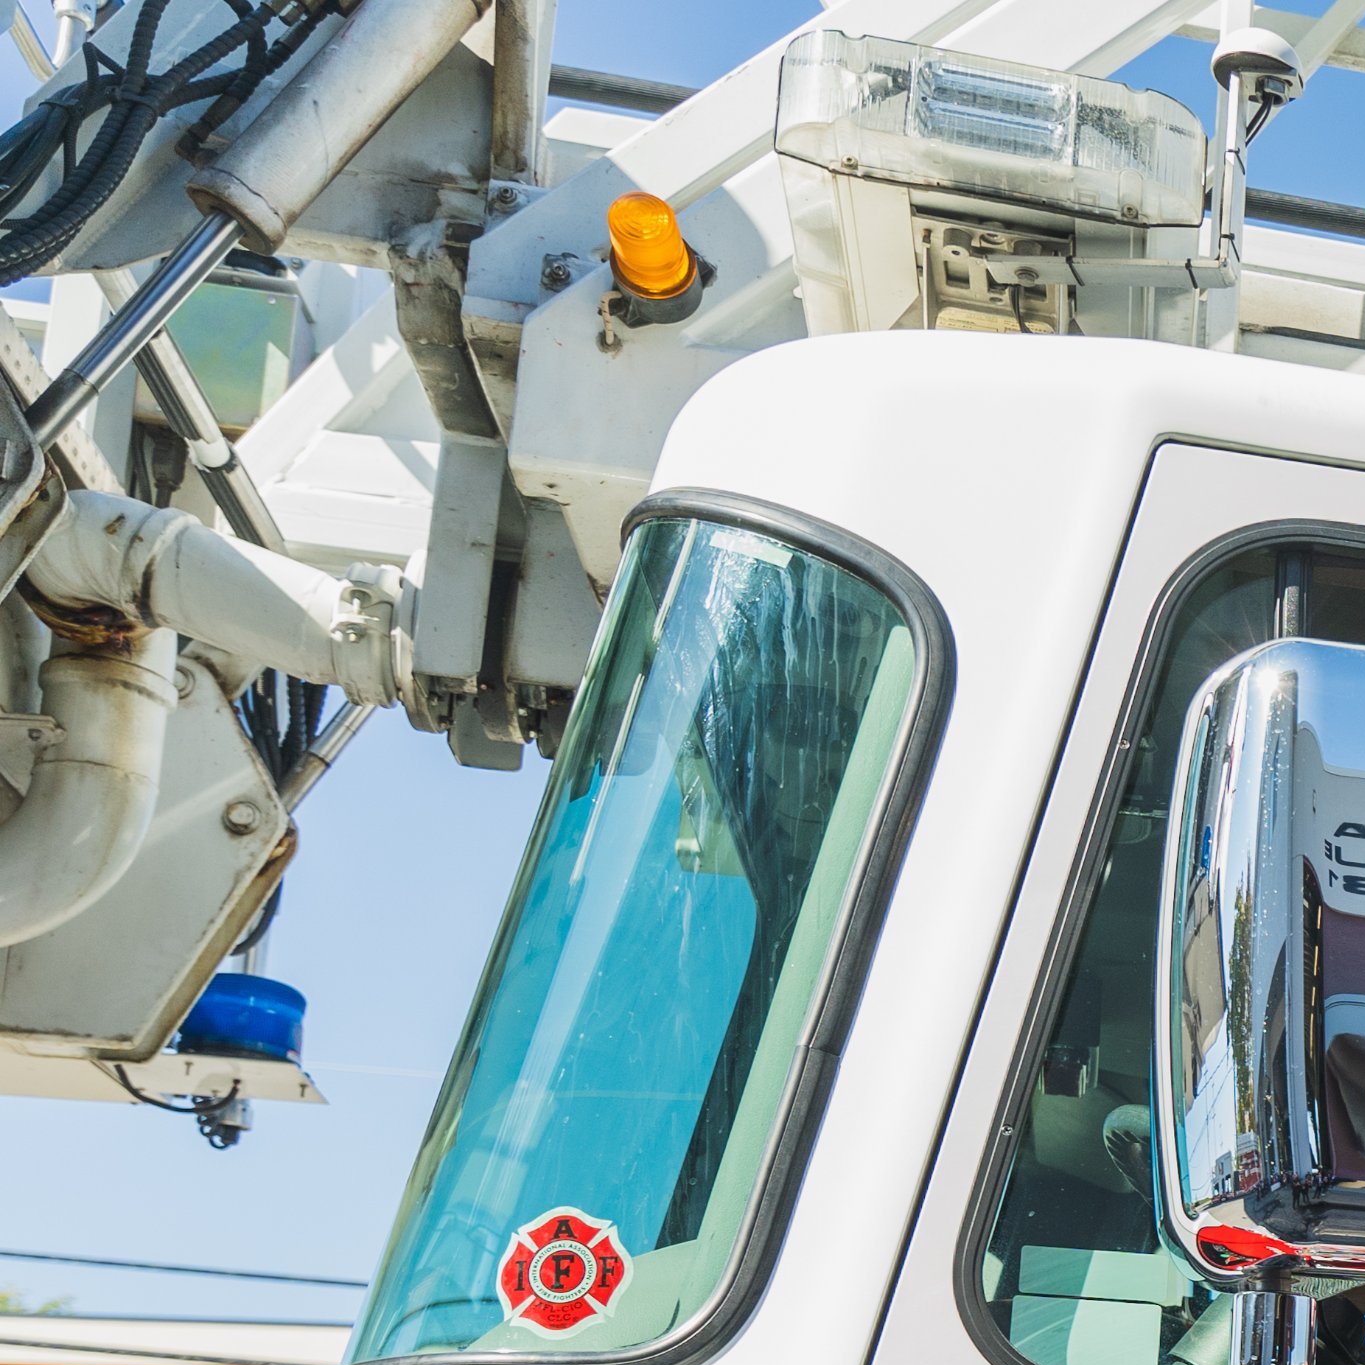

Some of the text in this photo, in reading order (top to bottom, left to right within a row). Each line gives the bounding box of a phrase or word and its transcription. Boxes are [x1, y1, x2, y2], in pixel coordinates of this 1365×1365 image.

[549, 1219, 578, 1240] A
[514, 1254, 618, 1291] I F F
[531, 1243, 594, 1284] INTERNATIONAL ASSOCIATION
